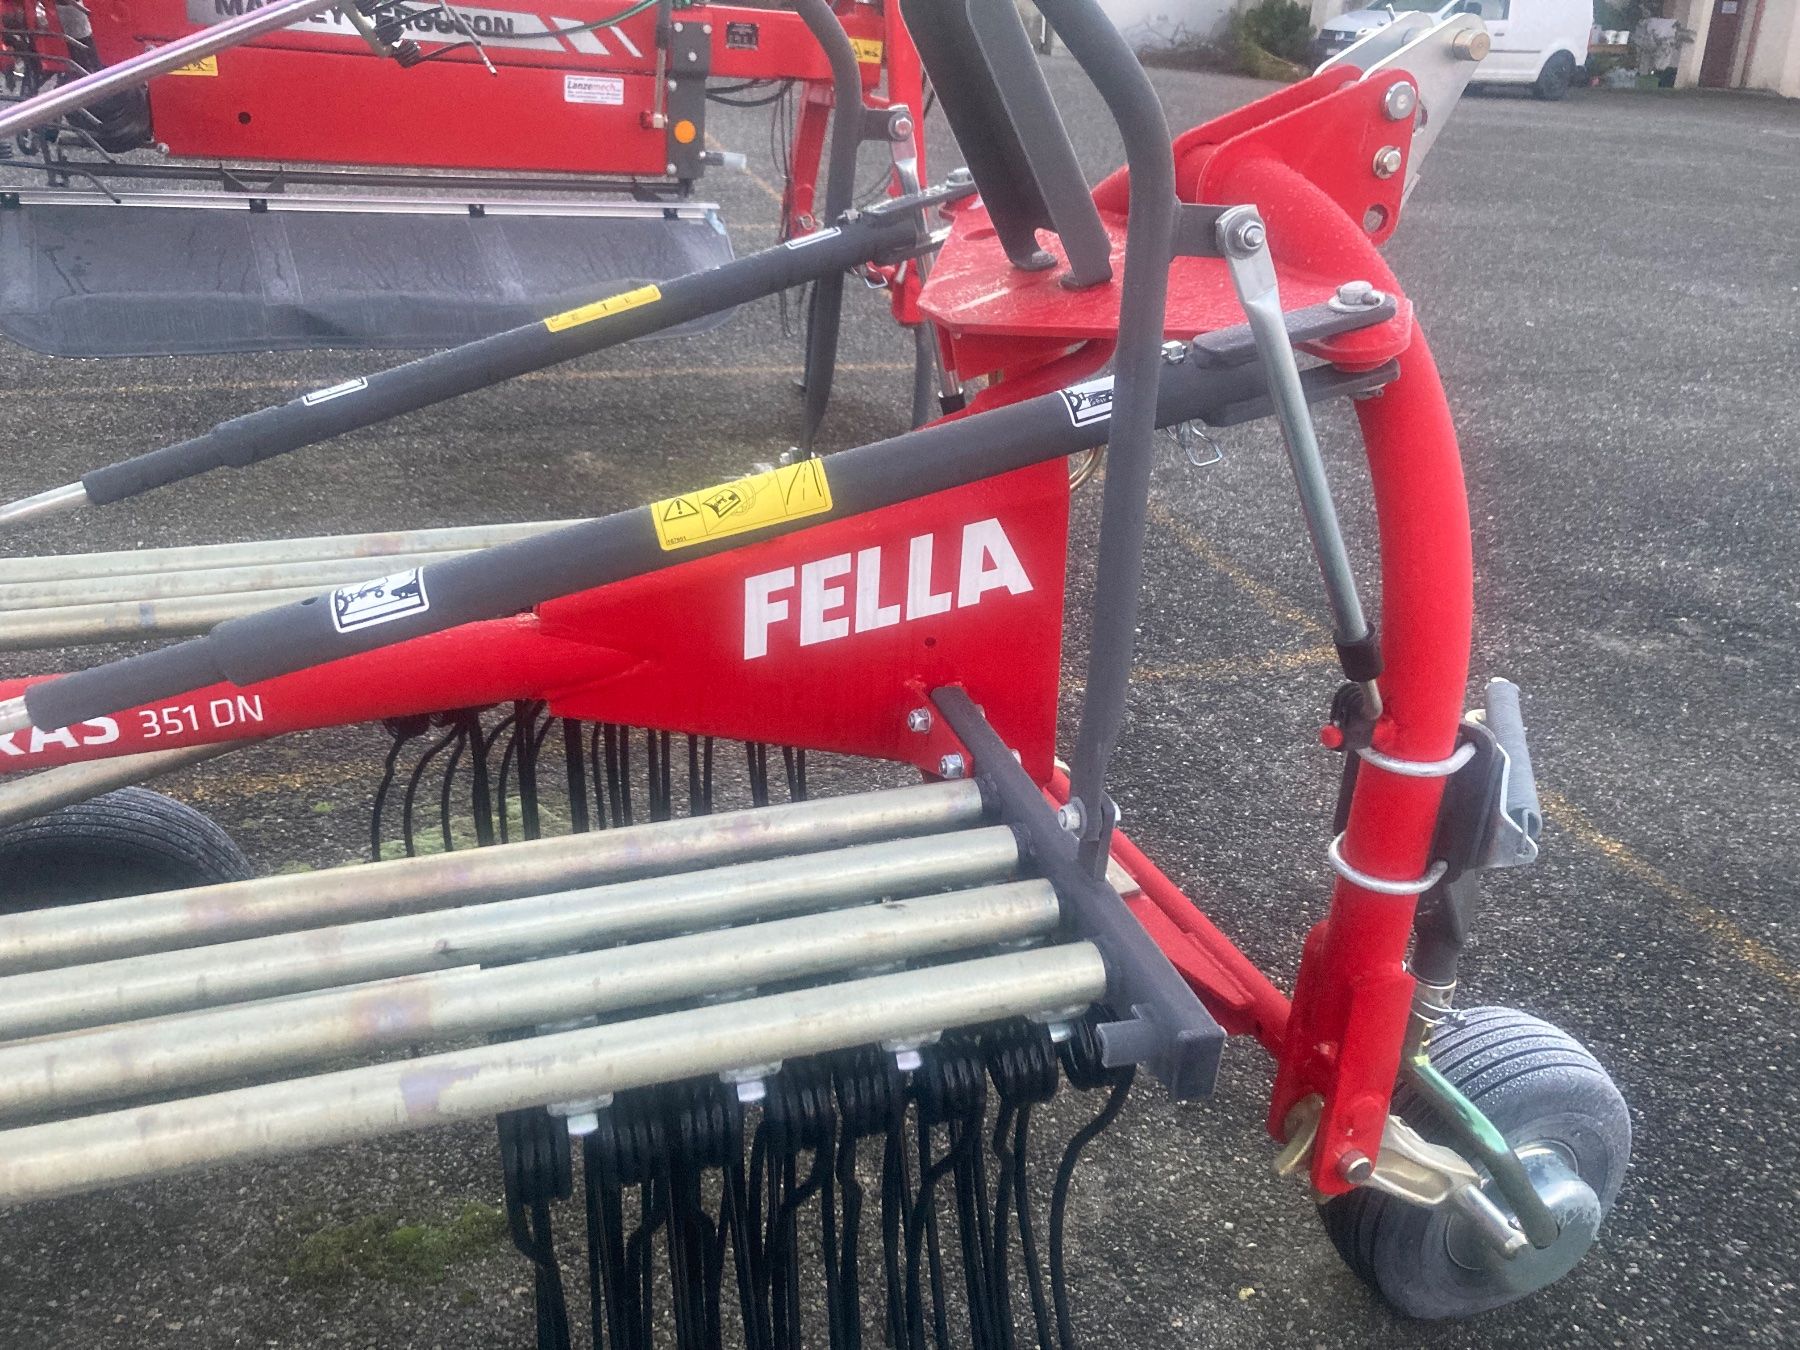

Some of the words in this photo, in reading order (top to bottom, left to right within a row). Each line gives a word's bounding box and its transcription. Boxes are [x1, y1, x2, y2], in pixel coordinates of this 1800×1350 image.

[744, 517, 1034, 660] FELLA
[138, 704, 200, 738] 351
[210, 694, 264, 728] DN
